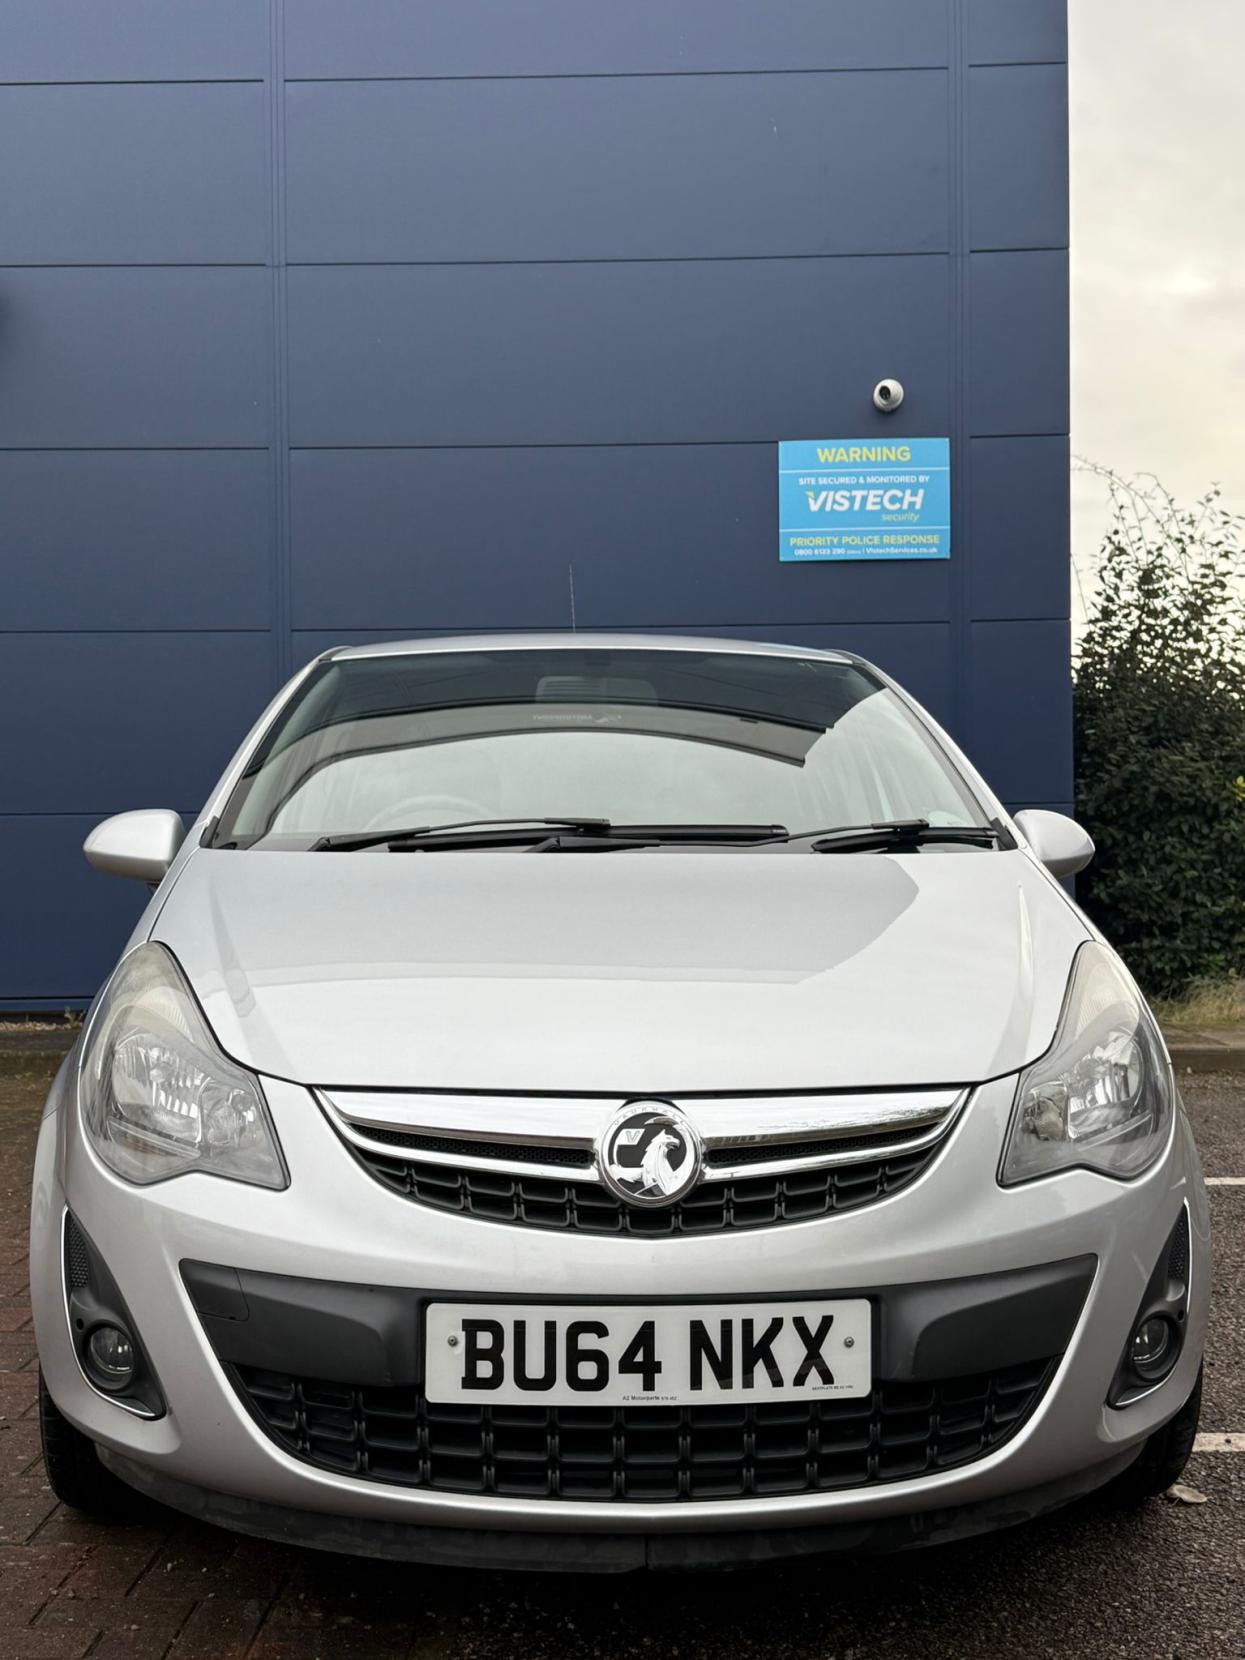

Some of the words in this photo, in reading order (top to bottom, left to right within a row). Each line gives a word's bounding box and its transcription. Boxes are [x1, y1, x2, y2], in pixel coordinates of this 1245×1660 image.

[816, 446, 911, 463] WARNING
[799, 477, 816, 485] SITE
[818, 476, 856, 485] SECURED
[858, 476, 864, 485] &
[866, 475, 917, 484] MONITORED
[918, 475, 930, 483] BY
[805, 489, 924, 512] VISTECH
[880, 512, 919, 522] security
[789, 536, 838, 547] PRIORITY
[842, 535, 880, 545] POLICE
[883, 534, 940, 545] RESPONSE
[794, 548, 813, 556] 0800
[461, 1318, 662, 1392] BU64
[689, 1315, 835, 1391] NKX
